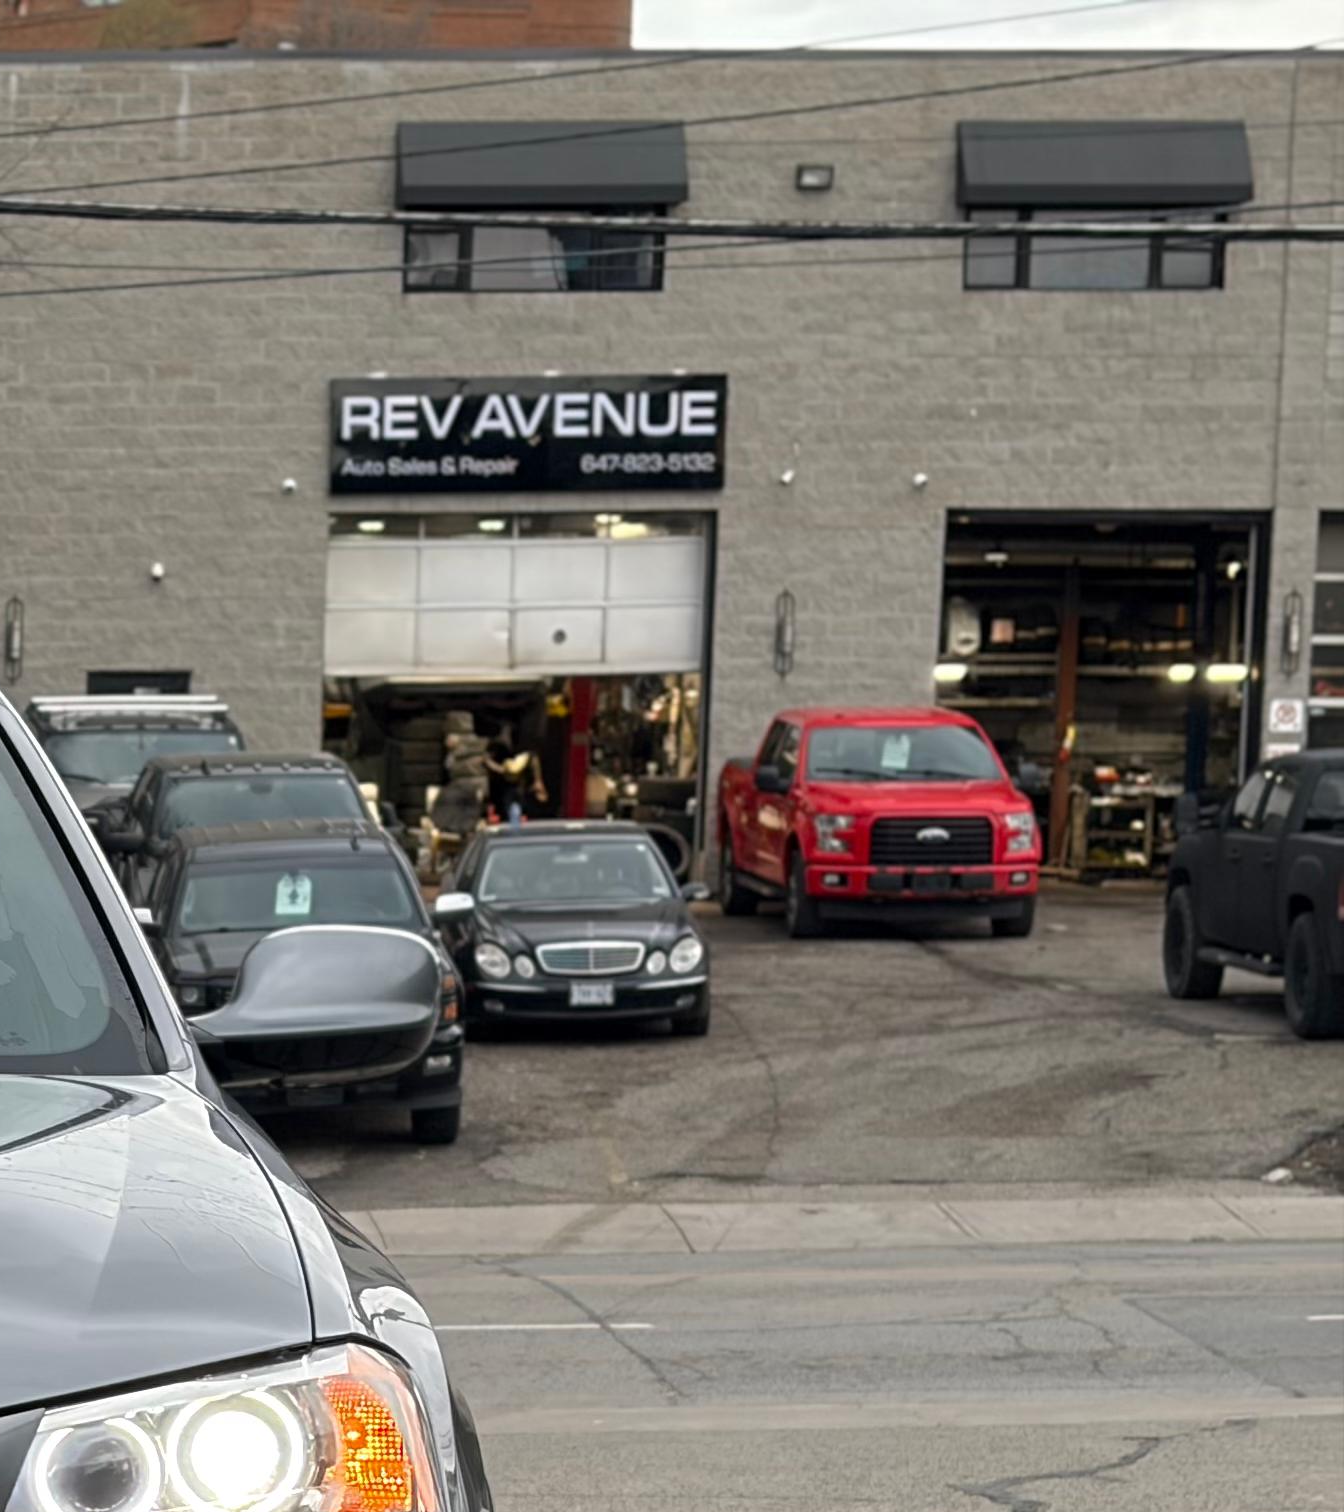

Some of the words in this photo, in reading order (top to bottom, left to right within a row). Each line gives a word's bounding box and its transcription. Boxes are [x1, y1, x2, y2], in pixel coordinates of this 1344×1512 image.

[340, 394, 462, 440] REV
[471, 391, 717, 438] AVENUE
[340, 457, 385, 477] Auto
[388, 455, 437, 477] Sales
[440, 455, 457, 476] &
[460, 455, 519, 478] Repair
[579, 451, 716, 474] 647-823-5132
